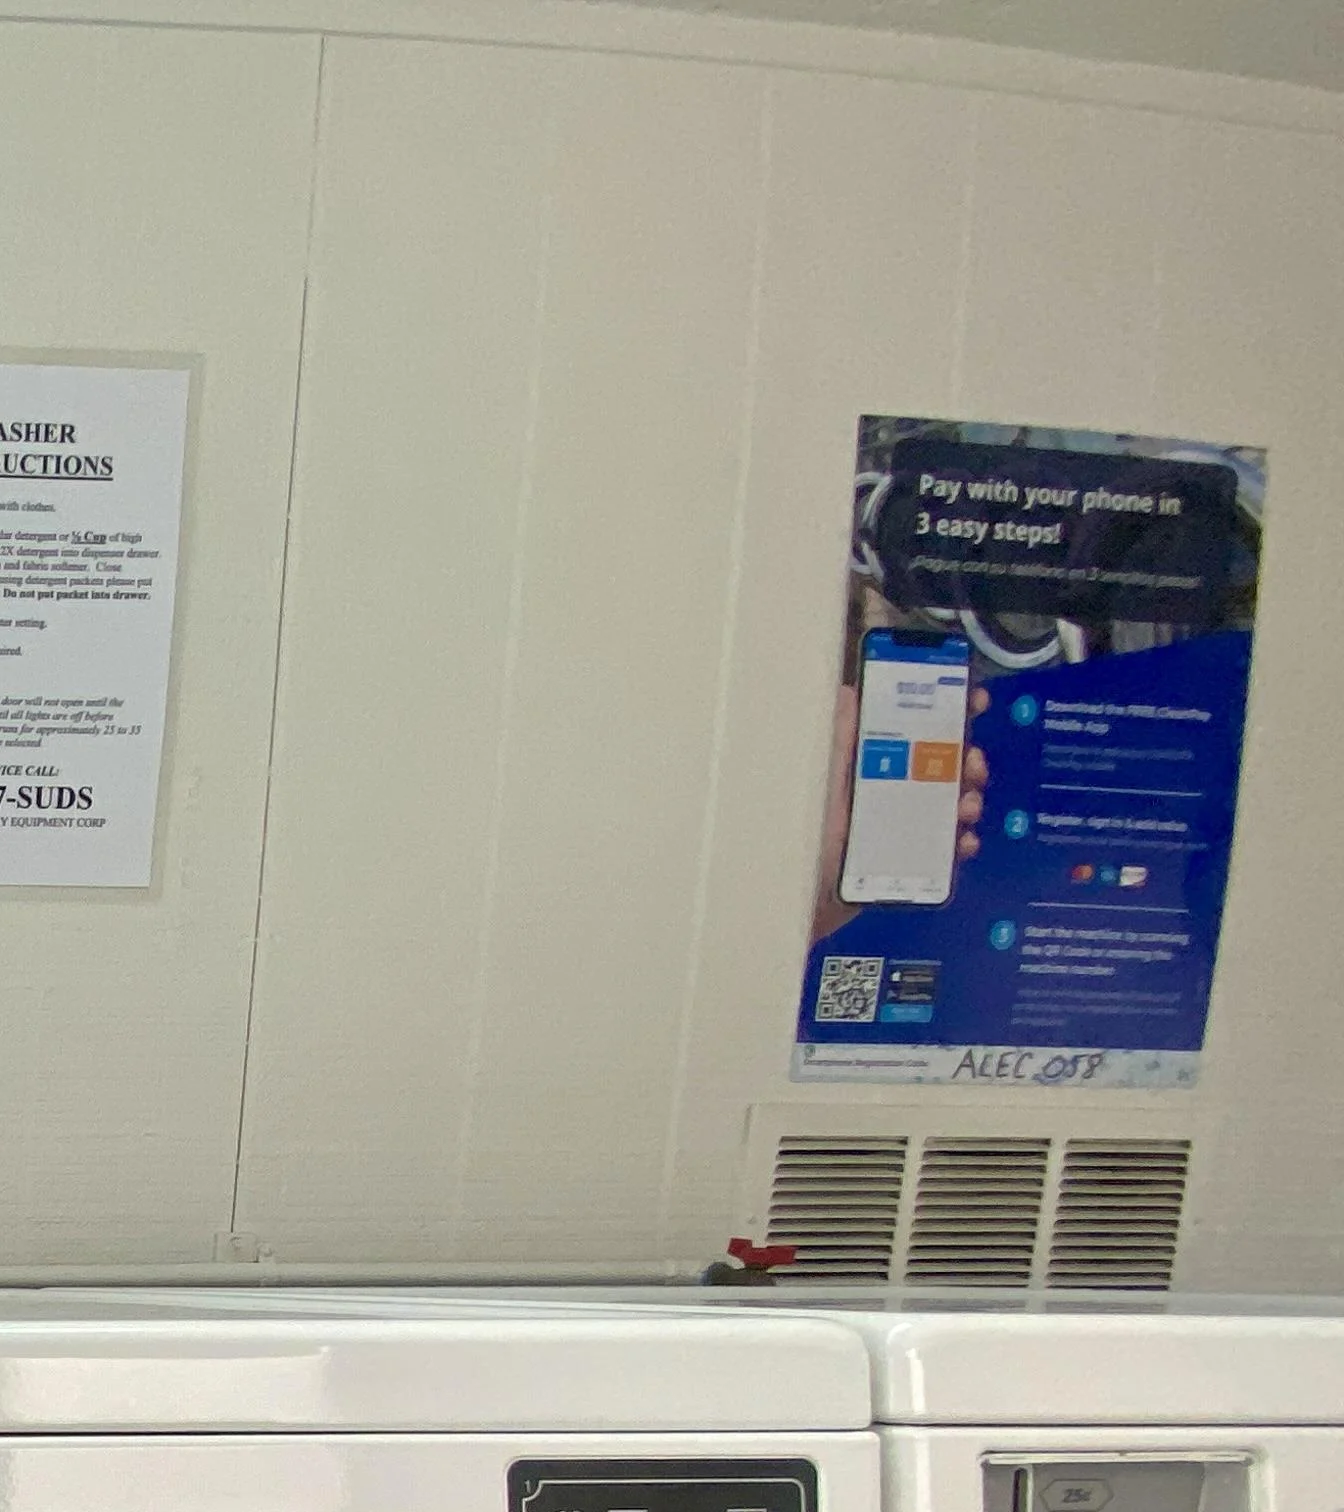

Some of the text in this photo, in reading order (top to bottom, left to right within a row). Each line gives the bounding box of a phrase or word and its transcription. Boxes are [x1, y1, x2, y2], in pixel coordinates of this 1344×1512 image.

[919, 474, 1180, 516] Pay with your phone in
[916, 512, 1062, 549] 3 easy steps!
[26, 766, 59, 777] CALL:
[11, 817, 73, 828] EQUIPMENT
[76, 818, 105, 828] CORP
